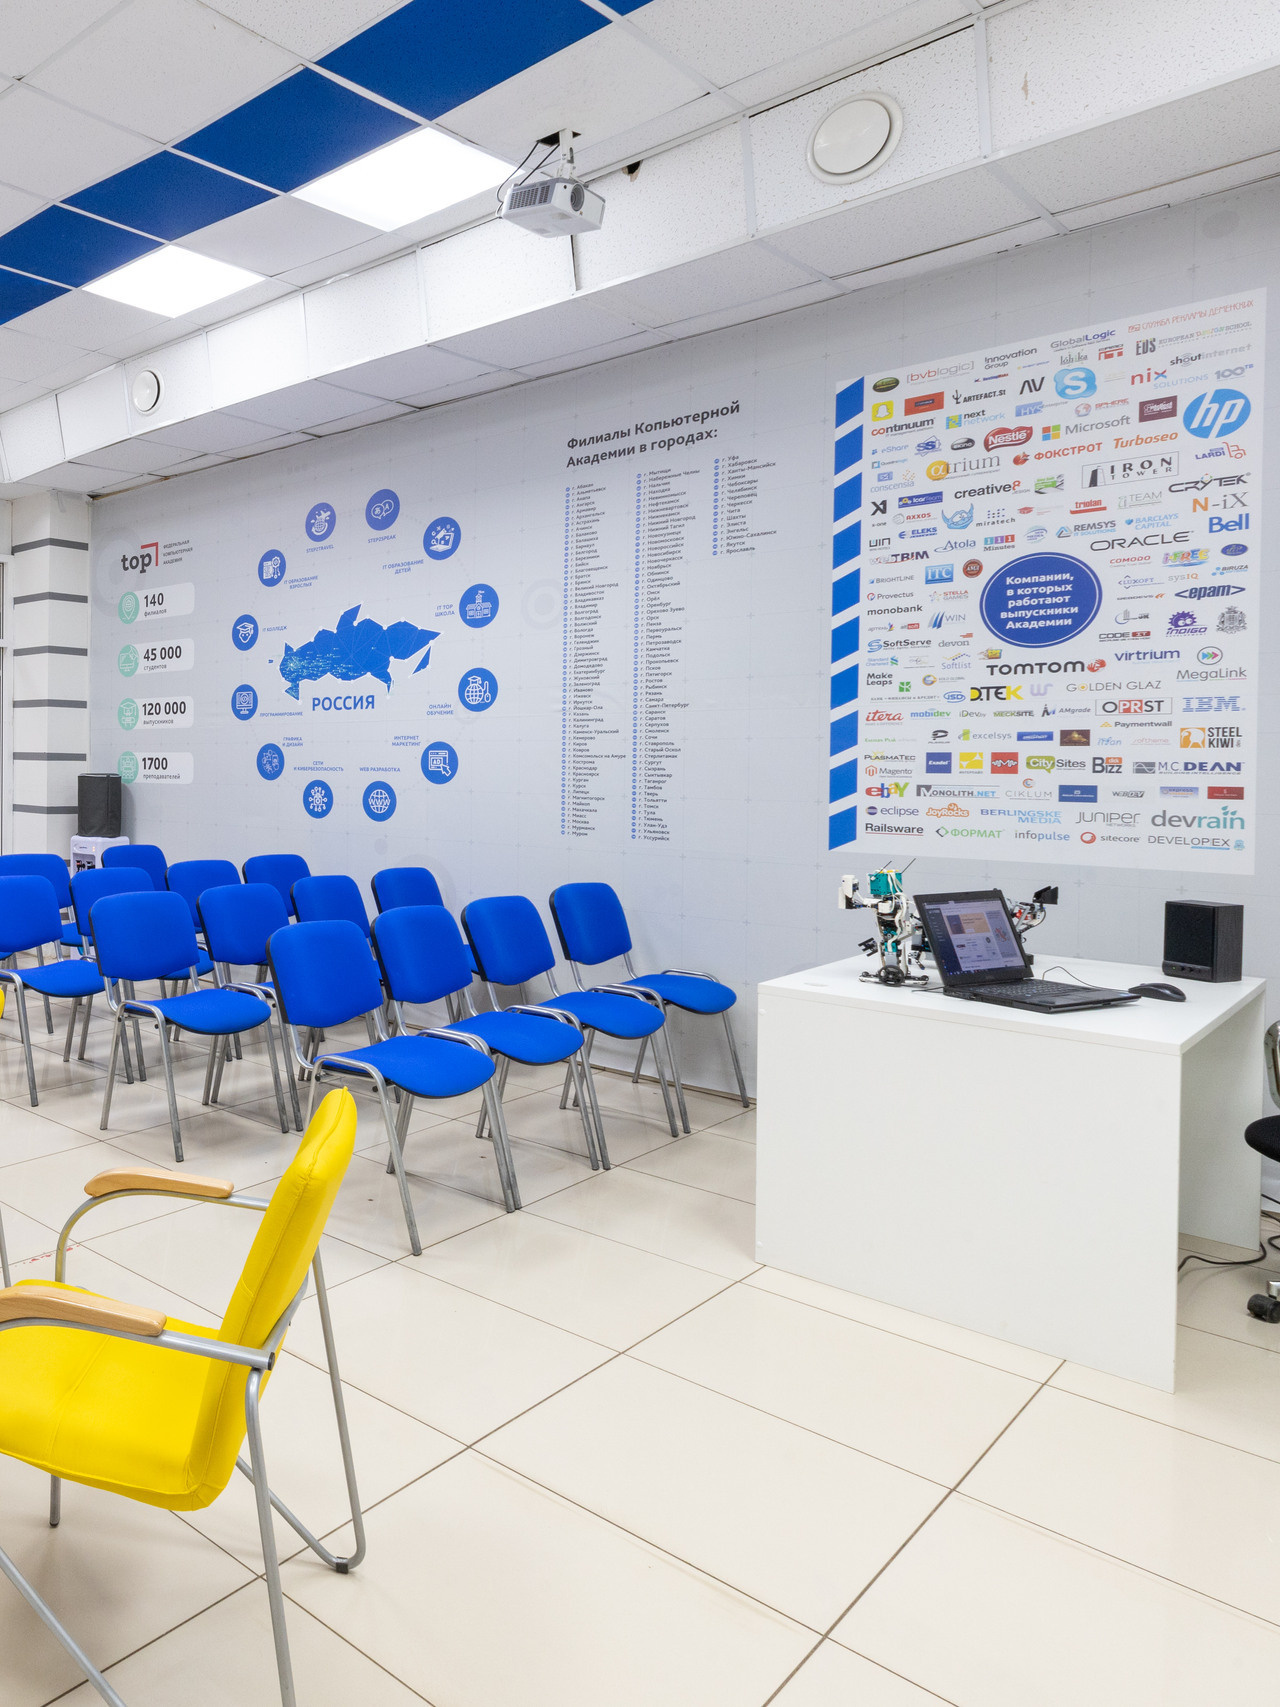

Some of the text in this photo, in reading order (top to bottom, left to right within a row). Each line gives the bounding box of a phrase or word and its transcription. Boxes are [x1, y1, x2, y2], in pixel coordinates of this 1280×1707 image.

[1159, 333, 1194, 344] EUROPEAN
[1225, 322, 1251, 332] SCHOOL
[1050, 330, 1116, 348] GlobalLogic
[984, 361, 1008, 370] Group
[1131, 369, 1167, 385] nix
[1154, 374, 1208, 389] SOLUTIONS
[964, 410, 985, 419] next
[964, 412, 1005, 425] network
[567, 400, 740, 449] Филиалы Копьютерной
[871, 419, 934, 436] continuum
[1065, 415, 1130, 435] Microsoft
[1114, 432, 1178, 449] Turboseo
[566, 428, 718, 468] Академии в городах:
[1034, 442, 1102, 460] ФОКСТРОТ
[728, 459, 757, 468] Хабаровск
[1111, 457, 1172, 474] IRON
[1112, 467, 1172, 480] TOWER
[871, 480, 914, 492] conscensia
[727, 493, 757, 501] Череповец
[976, 518, 1015, 527] miratech
[1136, 513, 1178, 523] BARCLAYS
[1208, 513, 1249, 533] Bell
[912, 527, 937, 535] ELEKS
[1074, 520, 1116, 531] REMSYS
[1135, 521, 1171, 530] CAPITAL
[367, 534, 397, 543] STEP2SPEAK
[1090, 531, 1190, 551] ORACLE
[944, 540, 976, 550] Atola
[121, 552, 152, 573] top
[388, 559, 424, 569] ОБРАЗОВАНИЕ
[1110, 555, 1151, 564] COMODO
[394, 567, 411, 575] ДЕТЕЙ
[927, 568, 951, 580] ITC
[288, 576, 318, 584] ОБРАЗОВАНИЕ
[1006, 573, 1074, 585] Компании,
[1007, 584, 1073, 597] в которых
[144, 593, 164, 607] 140
[1008, 596, 1071, 608] работают
[144, 609, 167, 617] филиалов
[867, 605, 923, 615] monobank
[1000, 606, 1078, 619] выпускники
[1006, 618, 1072, 630] Академии
[883, 639, 931, 647] SoftServe
[938, 640, 969, 648] devon
[144, 645, 182, 661] 45 000
[1114, 650, 1180, 661] virtrium
[941, 662, 972, 670] Softlist
[1176, 667, 1247, 681] MegaLink
[867, 679, 892, 687] Leaps
[1066, 681, 1161, 692] GOLDEN GLAZ
[142, 701, 186, 715] 120 000
[312, 695, 375, 711] РОССИЯ
[1102, 700, 1164, 713] OPRST
[1182, 696, 1241, 712] IBM
[865, 710, 904, 722] itera
[910, 710, 951, 718] mobidev
[972, 732, 1012, 740] excelsys
[1208, 727, 1242, 737] STEEL
[1208, 738, 1234, 748] KIWI
[142, 758, 168, 770] 1700
[1184, 762, 1241, 771] DEAN
[1005, 790, 1052, 798] CIKLUM
[881, 806, 919, 817] eclipse
[926, 808, 969, 817] JoyRocks
[980, 808, 1062, 818] BERLINGSKE
[1017, 816, 1062, 824] MEDIA
[1151, 810, 1245, 829] devrain
[865, 823, 924, 834] Railsware
[951, 829, 1002, 838] ФОРМАТ
[1014, 830, 1070, 842] infopulse
[1100, 835, 1140, 843] sitecore
